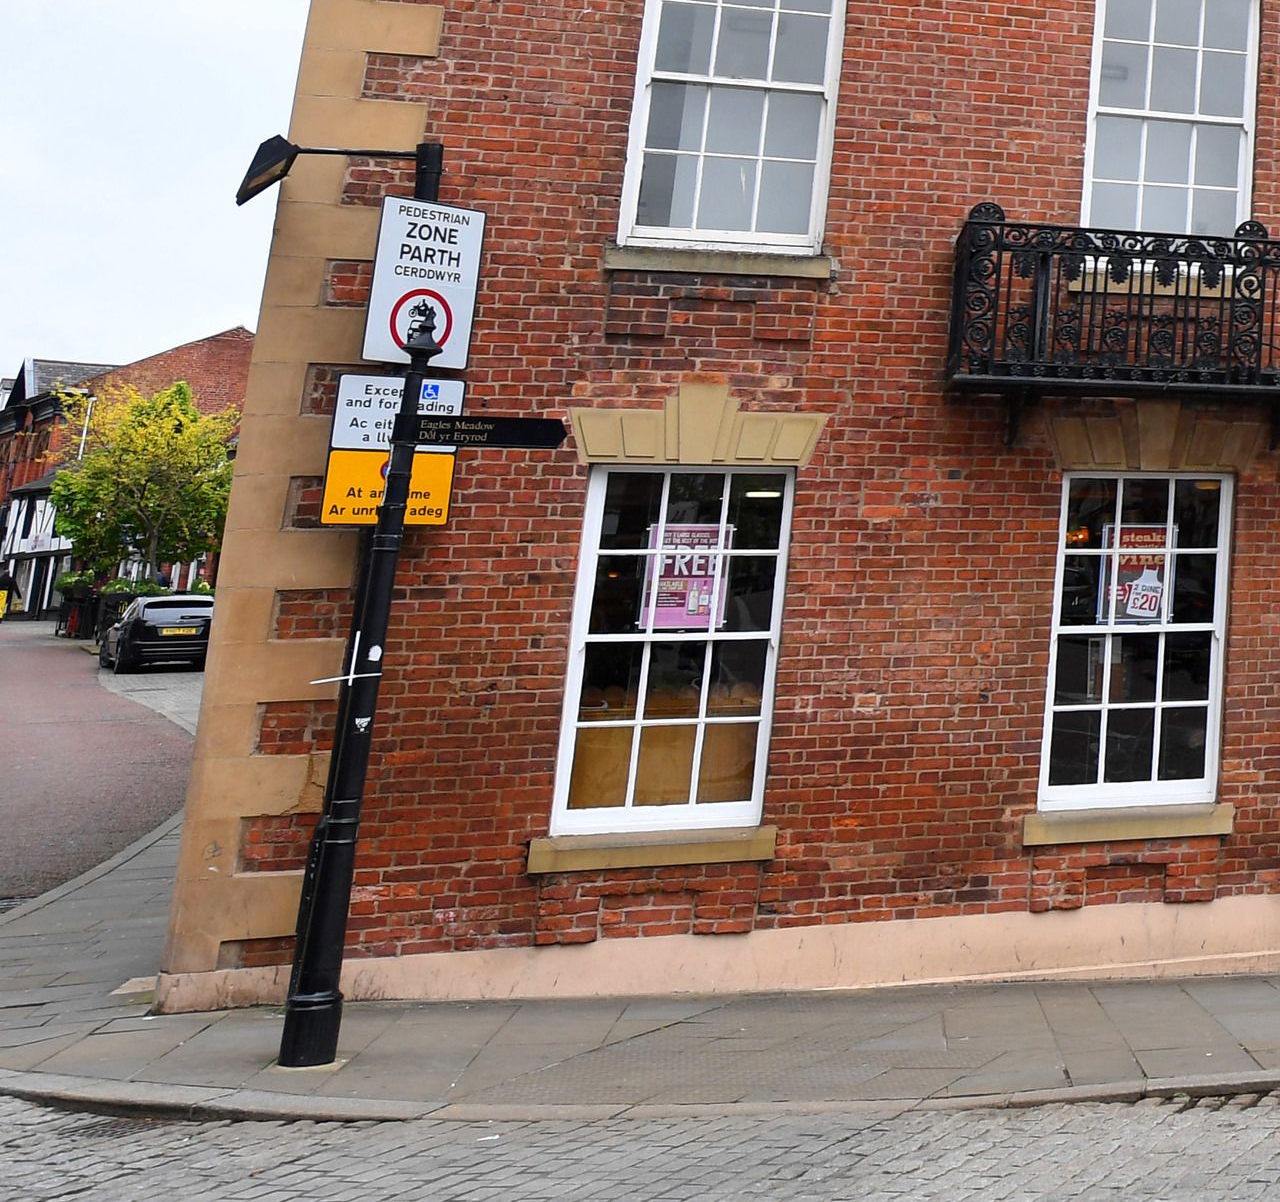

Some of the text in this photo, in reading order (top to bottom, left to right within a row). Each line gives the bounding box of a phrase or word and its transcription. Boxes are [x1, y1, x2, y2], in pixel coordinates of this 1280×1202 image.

[398, 205, 470, 226] PEDESTRIAN
[406, 222, 459, 245] ZONE
[399, 243, 461, 268] PARTH
[394, 265, 461, 283] CERDDWYR
[364, 384, 405, 398] Excep
[345, 398, 454, 414] and for ading
[349, 417, 368, 428] Ac
[420, 419, 495, 431] Eagles Meadow
[362, 433, 370, 442] a
[439, 432, 451, 443] yr
[453, 432, 488, 443] Eryrod
[346, 487, 362, 498] At
[329, 504, 346, 515] Ar
[409, 505, 443, 518] adeg
[1130, 593, 1158, 612] £20
